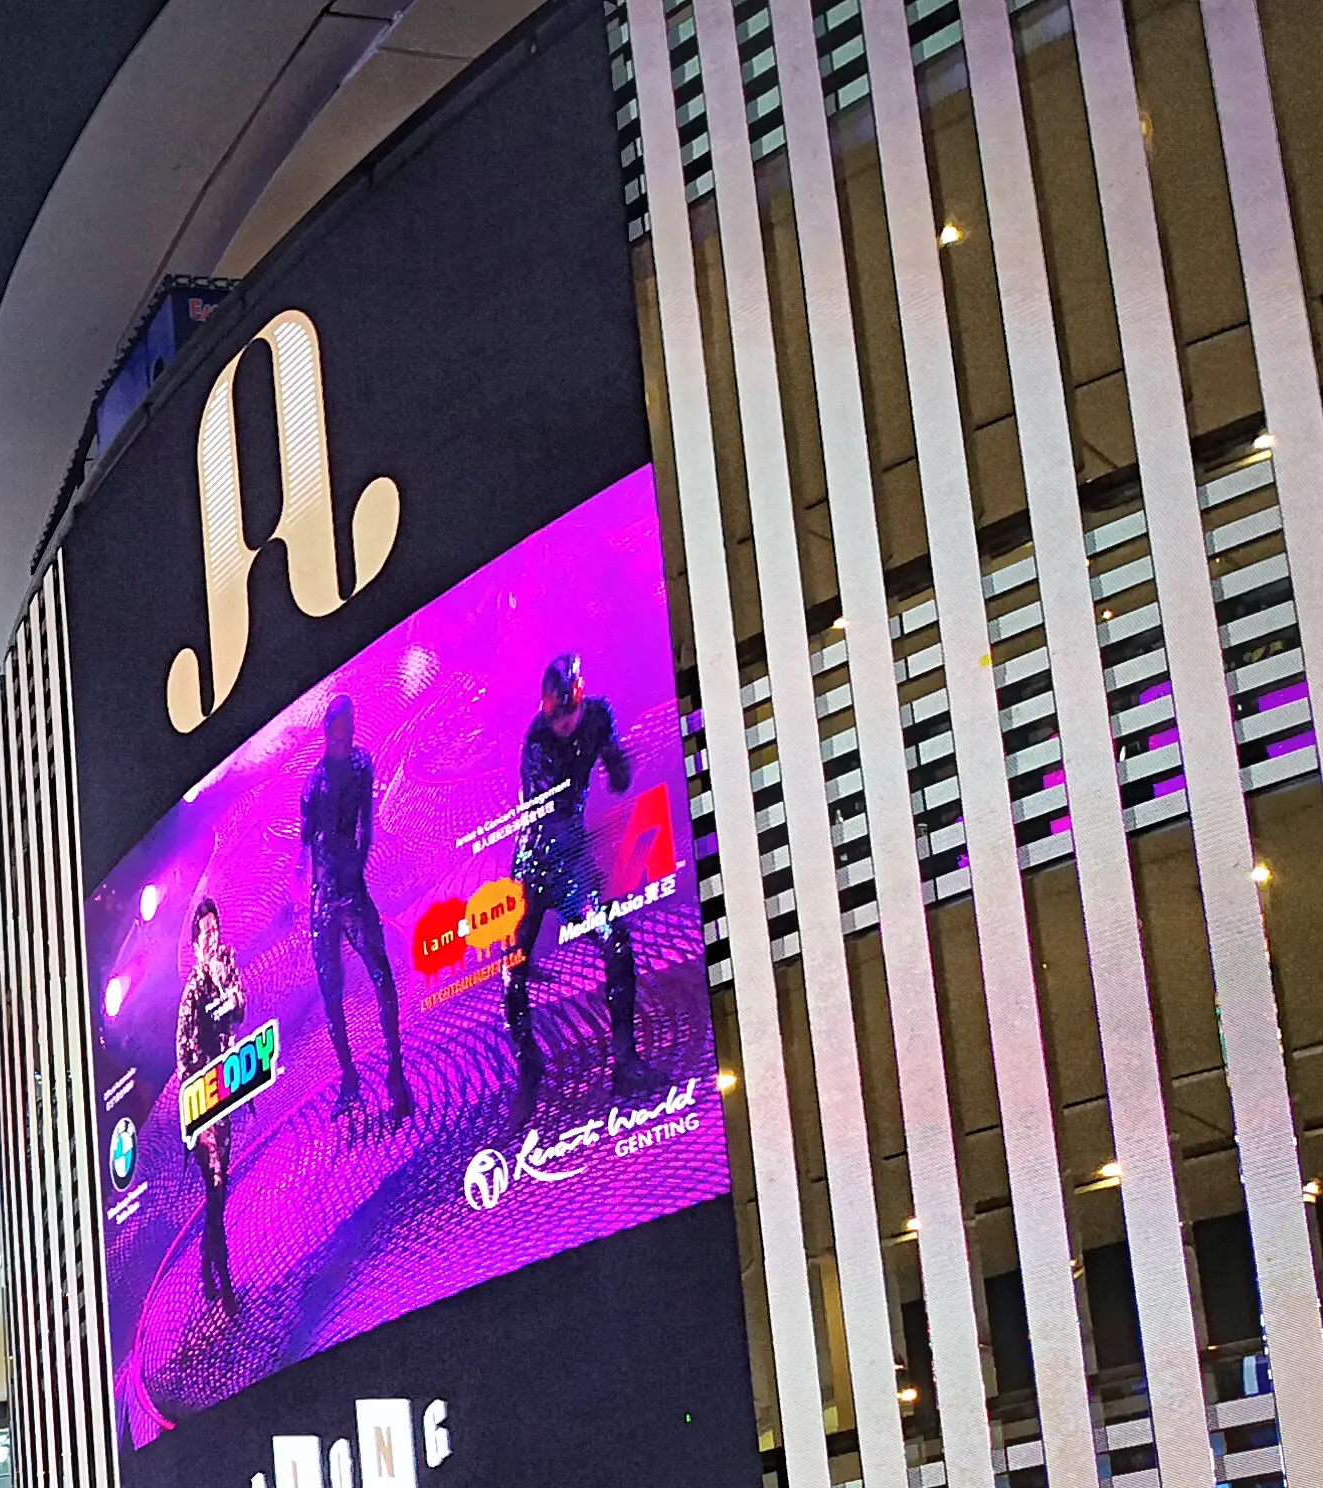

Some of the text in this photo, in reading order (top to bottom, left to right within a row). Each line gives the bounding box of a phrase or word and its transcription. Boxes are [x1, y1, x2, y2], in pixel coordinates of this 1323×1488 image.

[558, 906, 609, 945] Media
[608, 894, 645, 922] Asia
[183, 1024, 275, 1127] MELODY
[608, 1078, 702, 1137] World
[615, 1112, 701, 1158] GENTING
